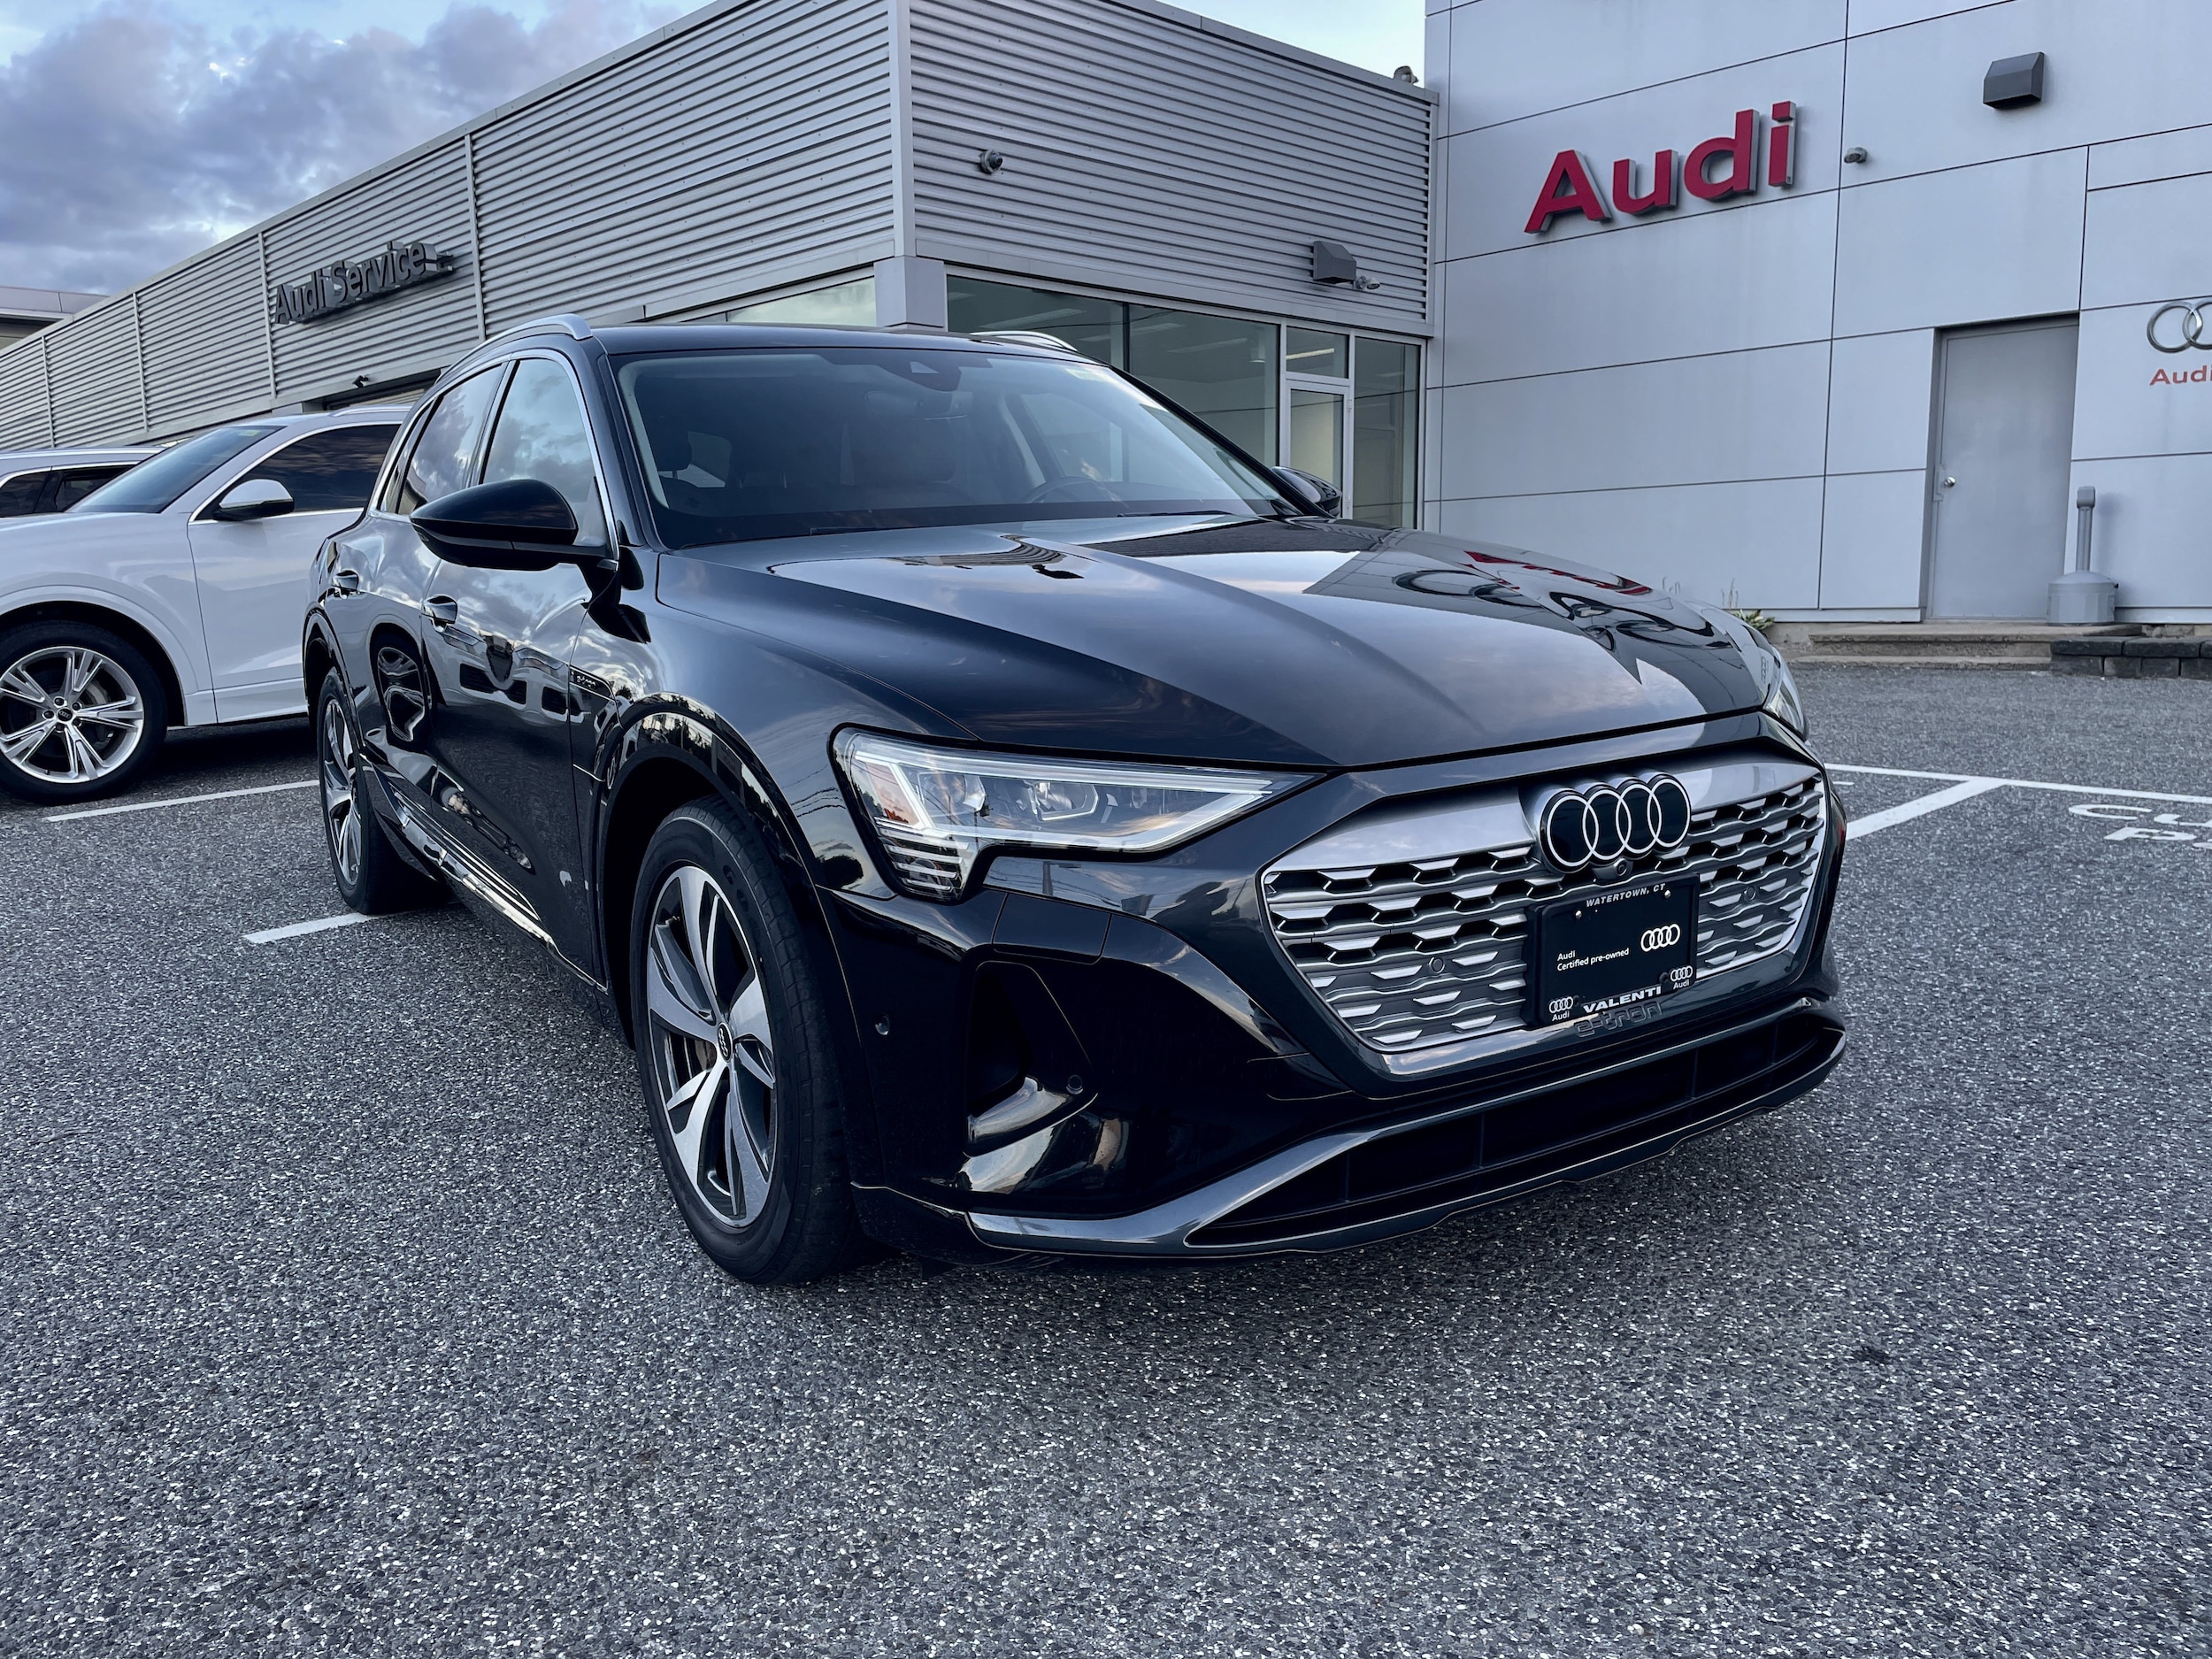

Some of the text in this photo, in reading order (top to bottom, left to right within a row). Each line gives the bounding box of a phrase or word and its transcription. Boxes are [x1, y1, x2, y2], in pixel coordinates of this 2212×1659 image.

[1524, 100, 1795, 234] Audi
[275, 241, 437, 324] Audi Service
[1586, 883, 1666, 908] WATERTOWN, CT
[1557, 950, 1576, 962] Audi
[1557, 948, 1630, 972] Certified pre-owned
[1673, 979, 1690, 990] Audi
[1583, 986, 1663, 1014] VALENTI
[1552, 1010, 1571, 1022] Audi
[1573, 1001, 1663, 1038] e-tron
